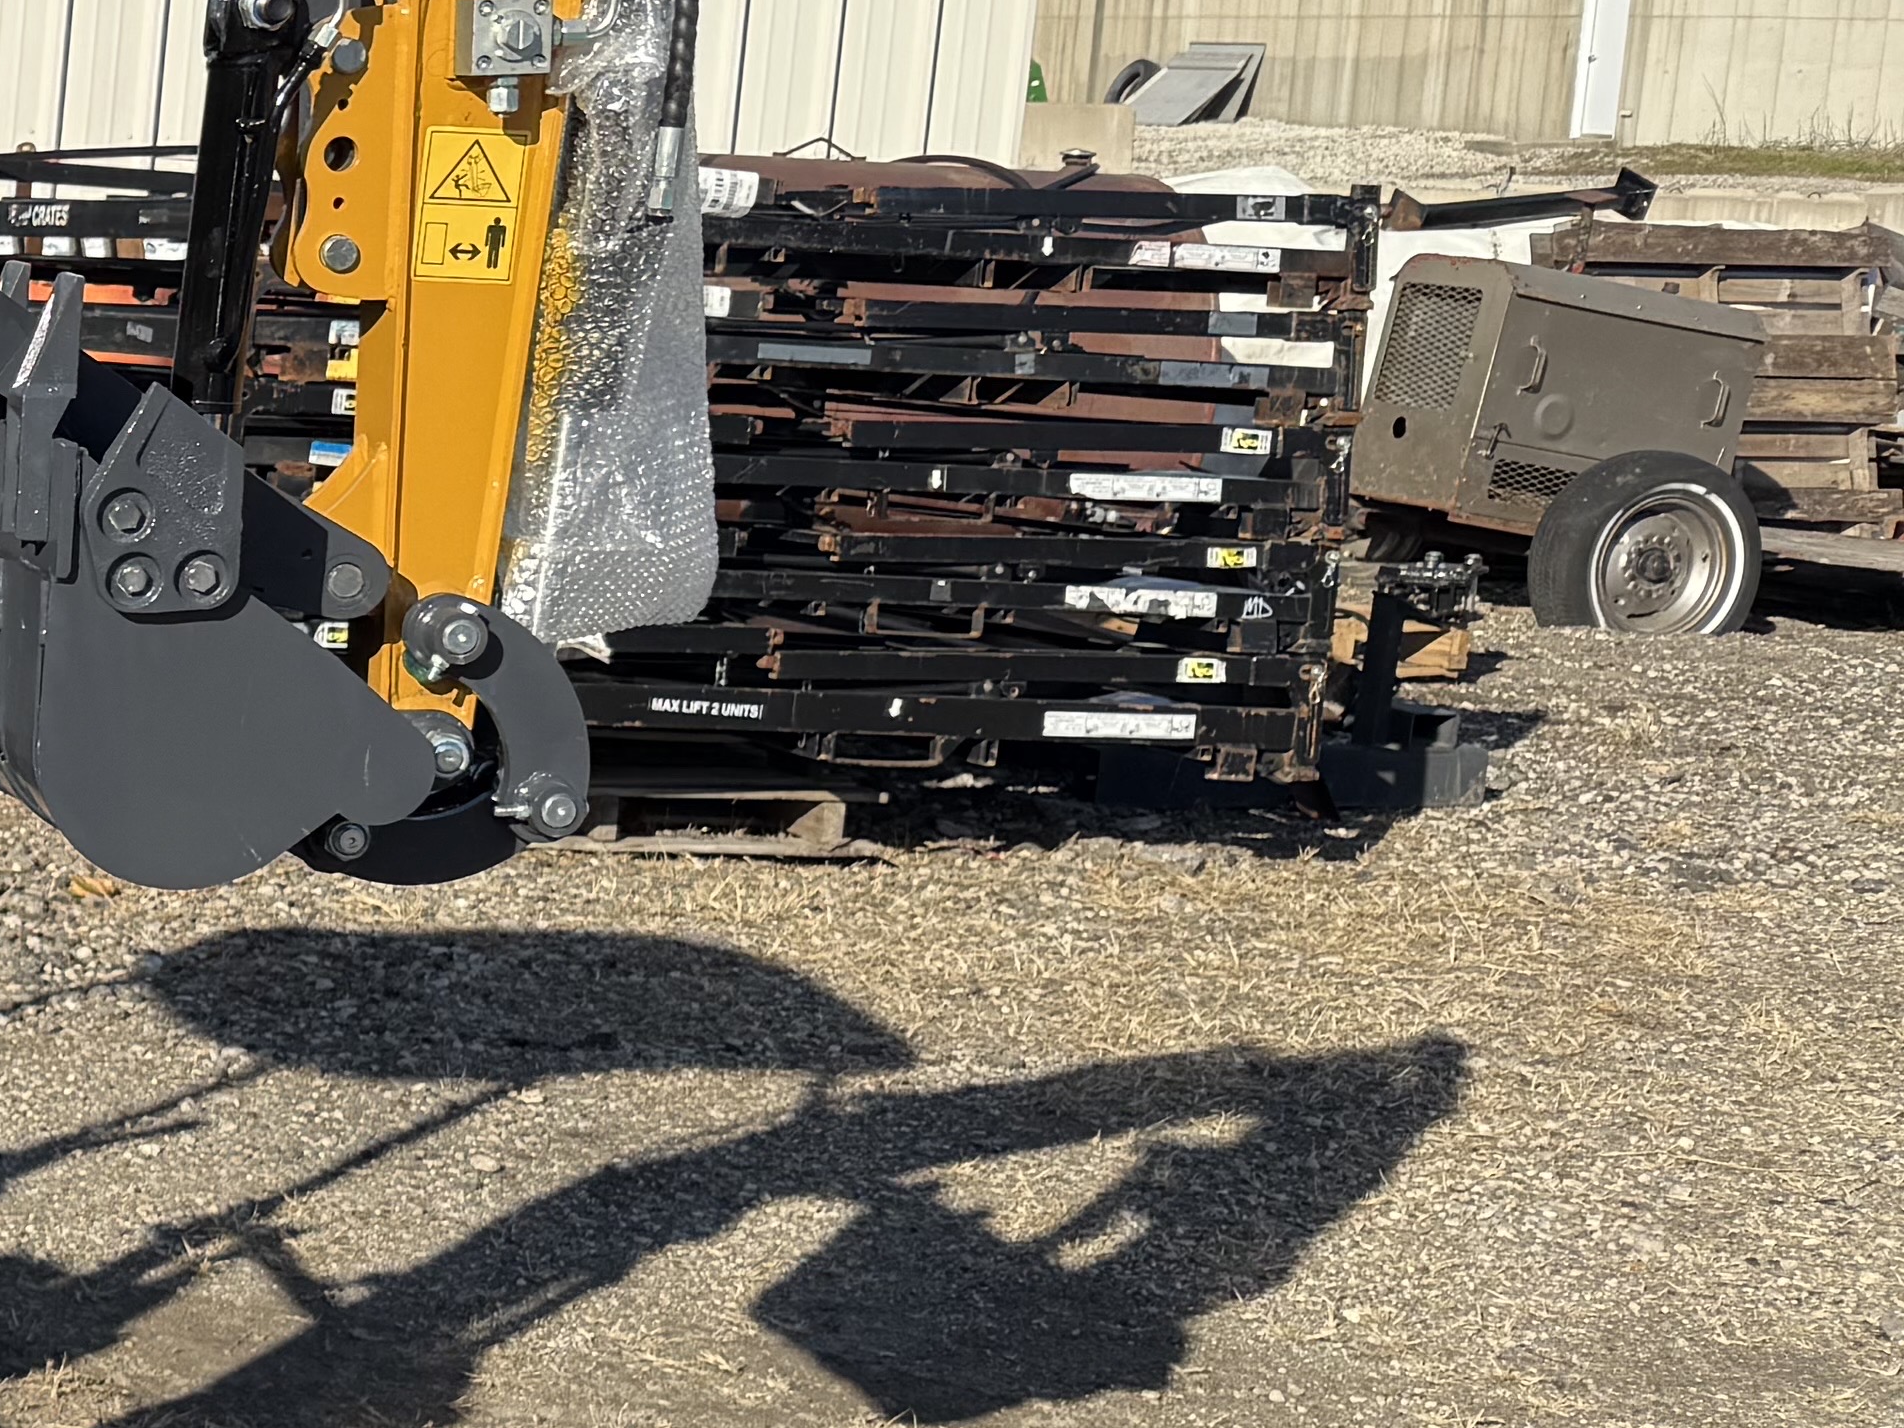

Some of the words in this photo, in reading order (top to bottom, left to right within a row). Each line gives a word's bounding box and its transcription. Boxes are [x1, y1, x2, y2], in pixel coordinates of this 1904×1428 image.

[31, 204, 71, 227] CRATES
[651, 697, 680, 712] MAX
[681, 700, 710, 715] LIFT
[710, 702, 720, 716] 2
[721, 702, 759, 719] UNITS
